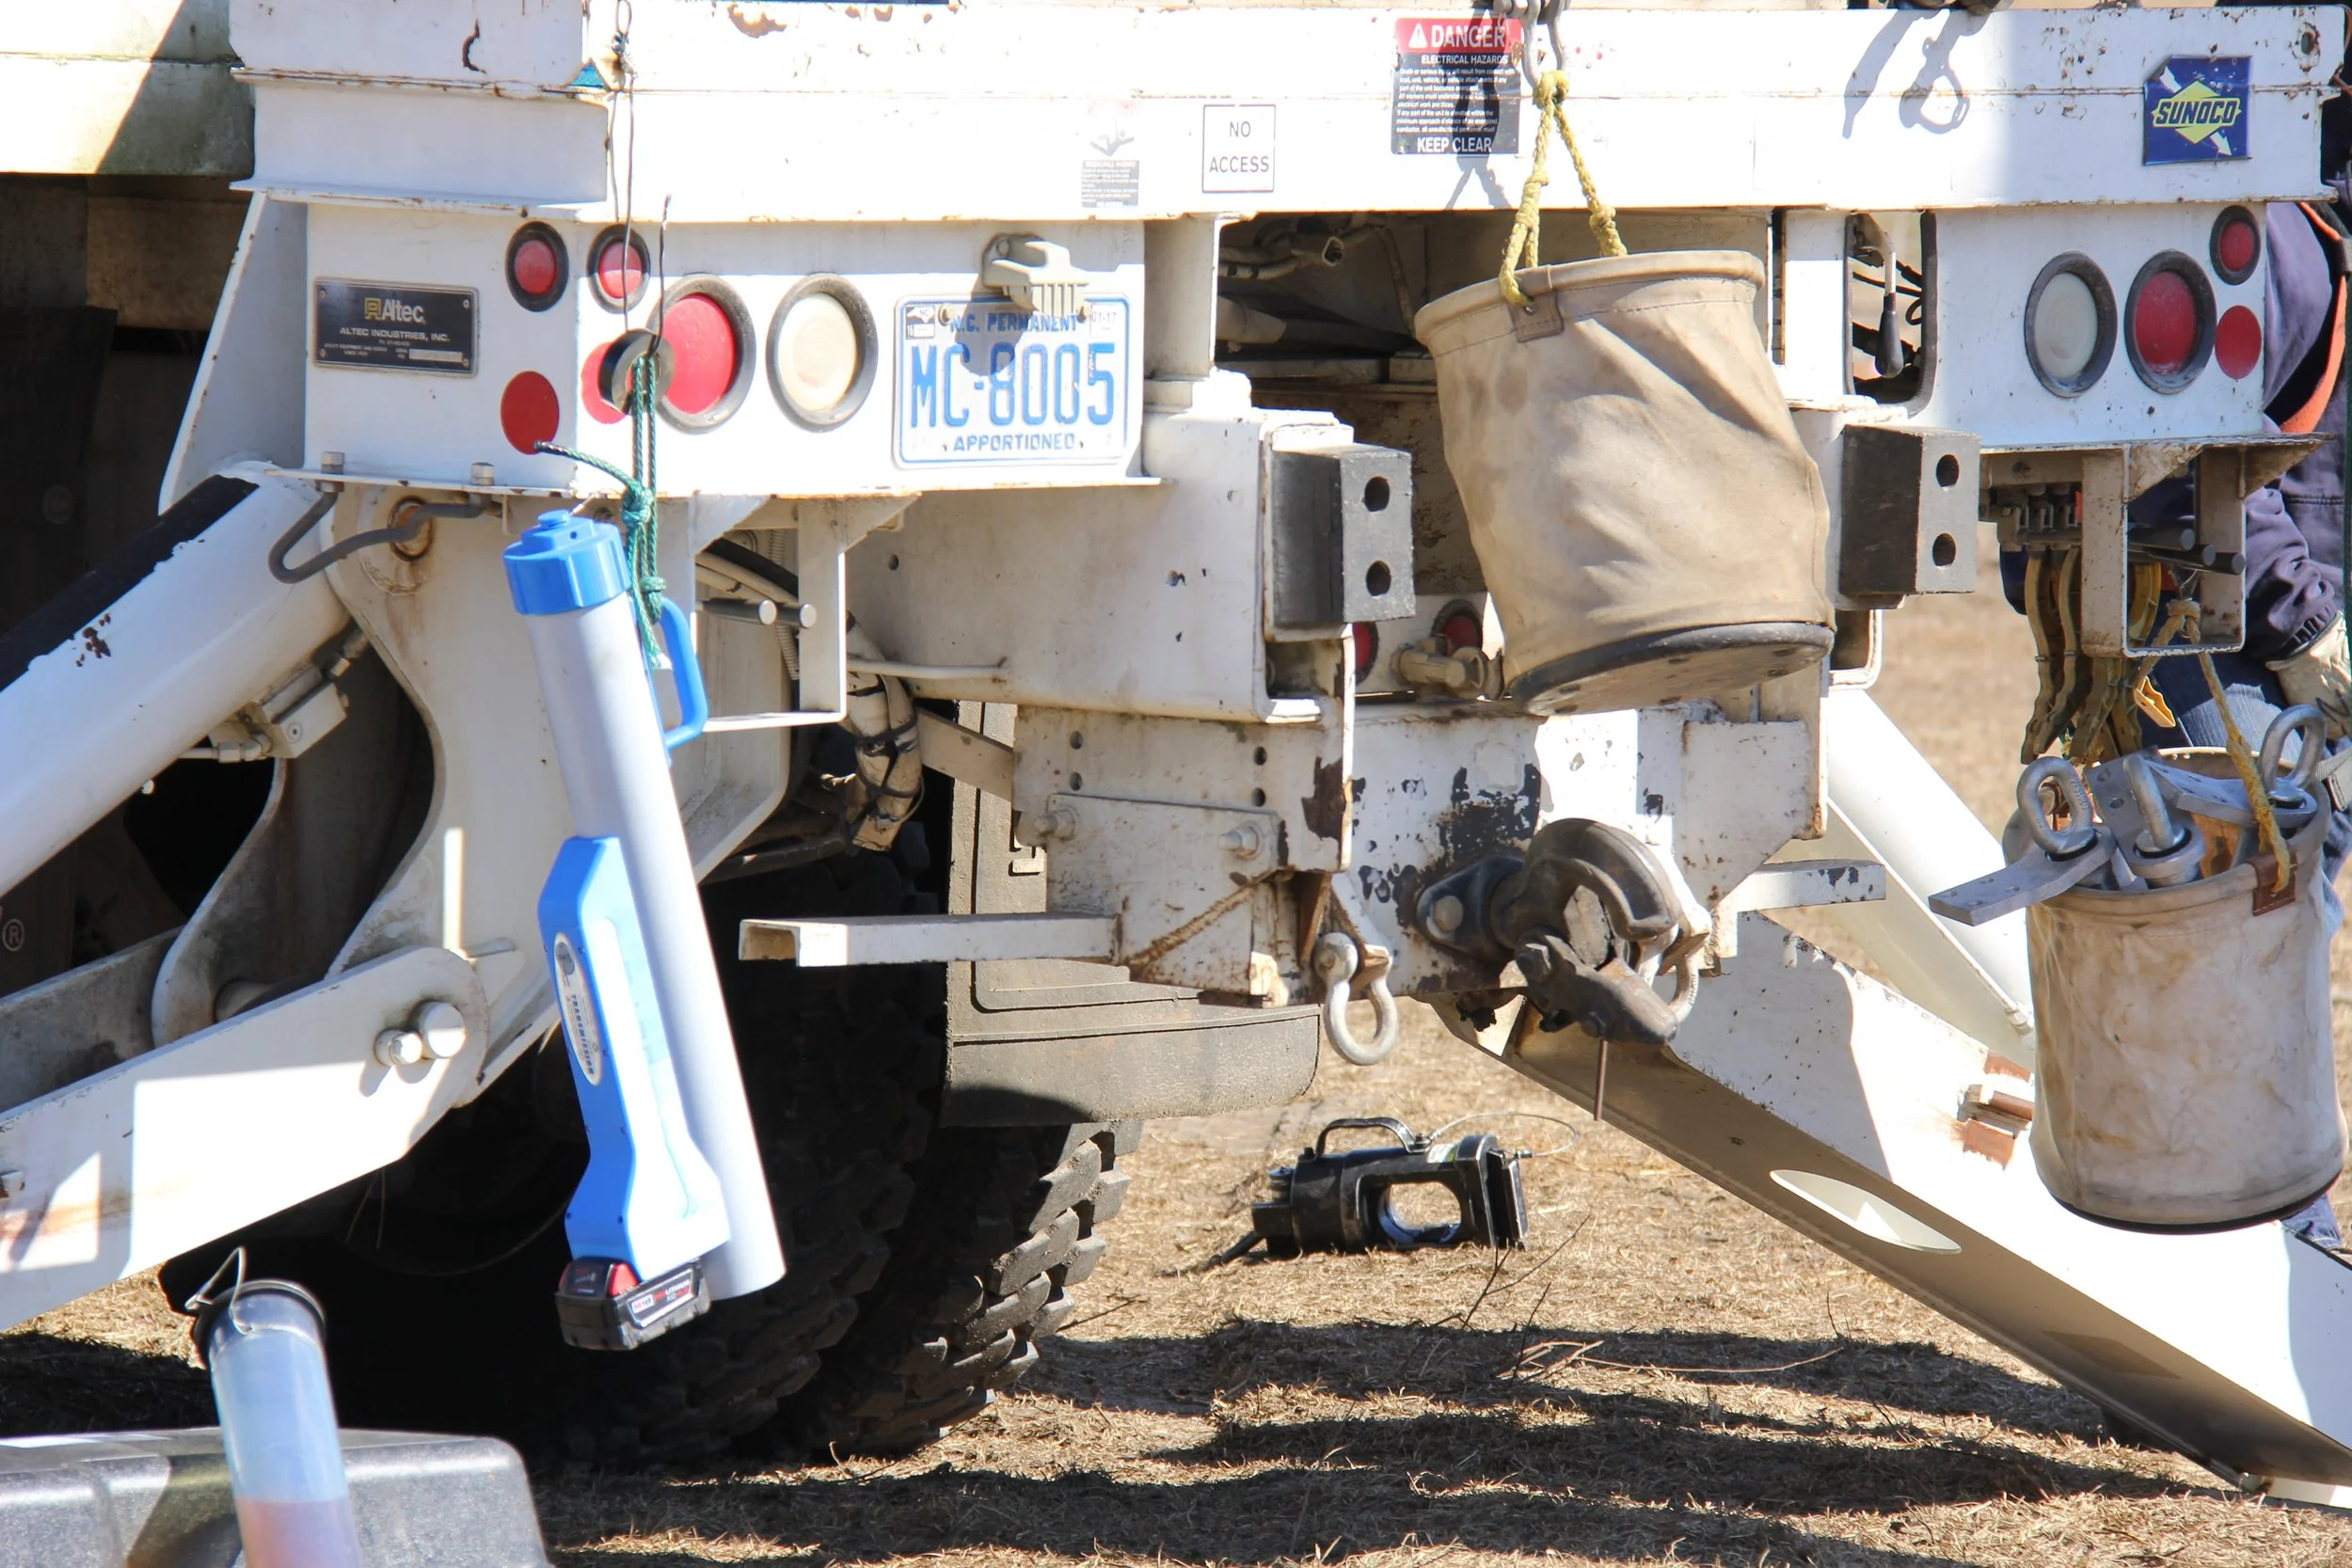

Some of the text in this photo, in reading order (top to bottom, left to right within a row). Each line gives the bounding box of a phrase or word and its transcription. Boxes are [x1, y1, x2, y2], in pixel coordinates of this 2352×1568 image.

[1431, 24, 1505, 47] DANGER
[1421, 55, 1508, 64] ELECTRICAL HAZARDS
[2155, 100, 2237, 124] SUNOCO
[1229, 121, 1251, 137] NO
[1417, 137, 1491, 152] KEEP CLEAR
[1209, 156, 1269, 173] ACCESS
[381, 298, 425, 322] Altec
[988, 312, 1078, 332] PERMANENT
[340, 326, 450, 341] ALTEC INDUSTRIES, INC.
[911, 341, 1116, 428] MC-8005
[953, 432, 1075, 452] APPORTIONED
